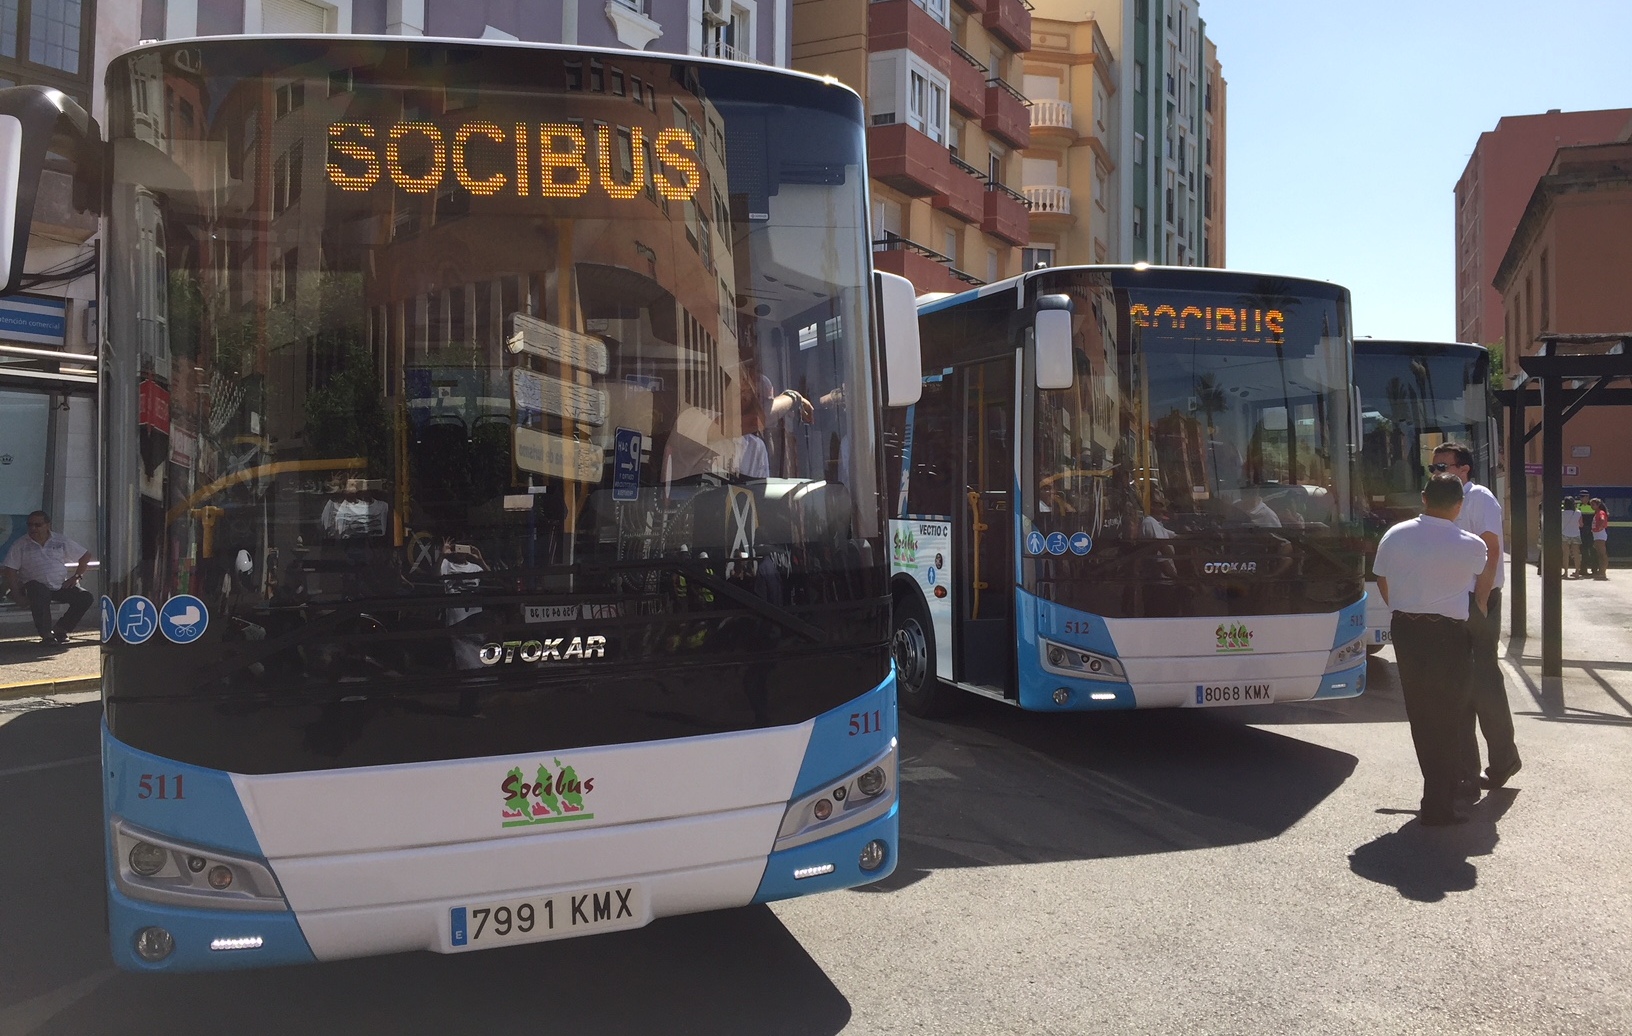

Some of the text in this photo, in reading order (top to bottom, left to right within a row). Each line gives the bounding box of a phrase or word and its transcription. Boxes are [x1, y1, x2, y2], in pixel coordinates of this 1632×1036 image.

[326, 120, 701, 201] SOCIBUS
[919, 524, 948, 537] VECTIO C
[1204, 561, 1257, 575] OTOKAR
[1064, 621, 1090, 635] 512
[1215, 625, 1254, 641] Socibus
[479, 635, 607, 666] OTOKAR
[1205, 684, 1271, 702] 8068 KMX
[848, 709, 881, 737] 511
[138, 773, 187, 801] 511
[501, 769, 595, 801] Socibus
[472, 888, 633, 940] 7991 KMX
[455, 930, 464, 940] E
